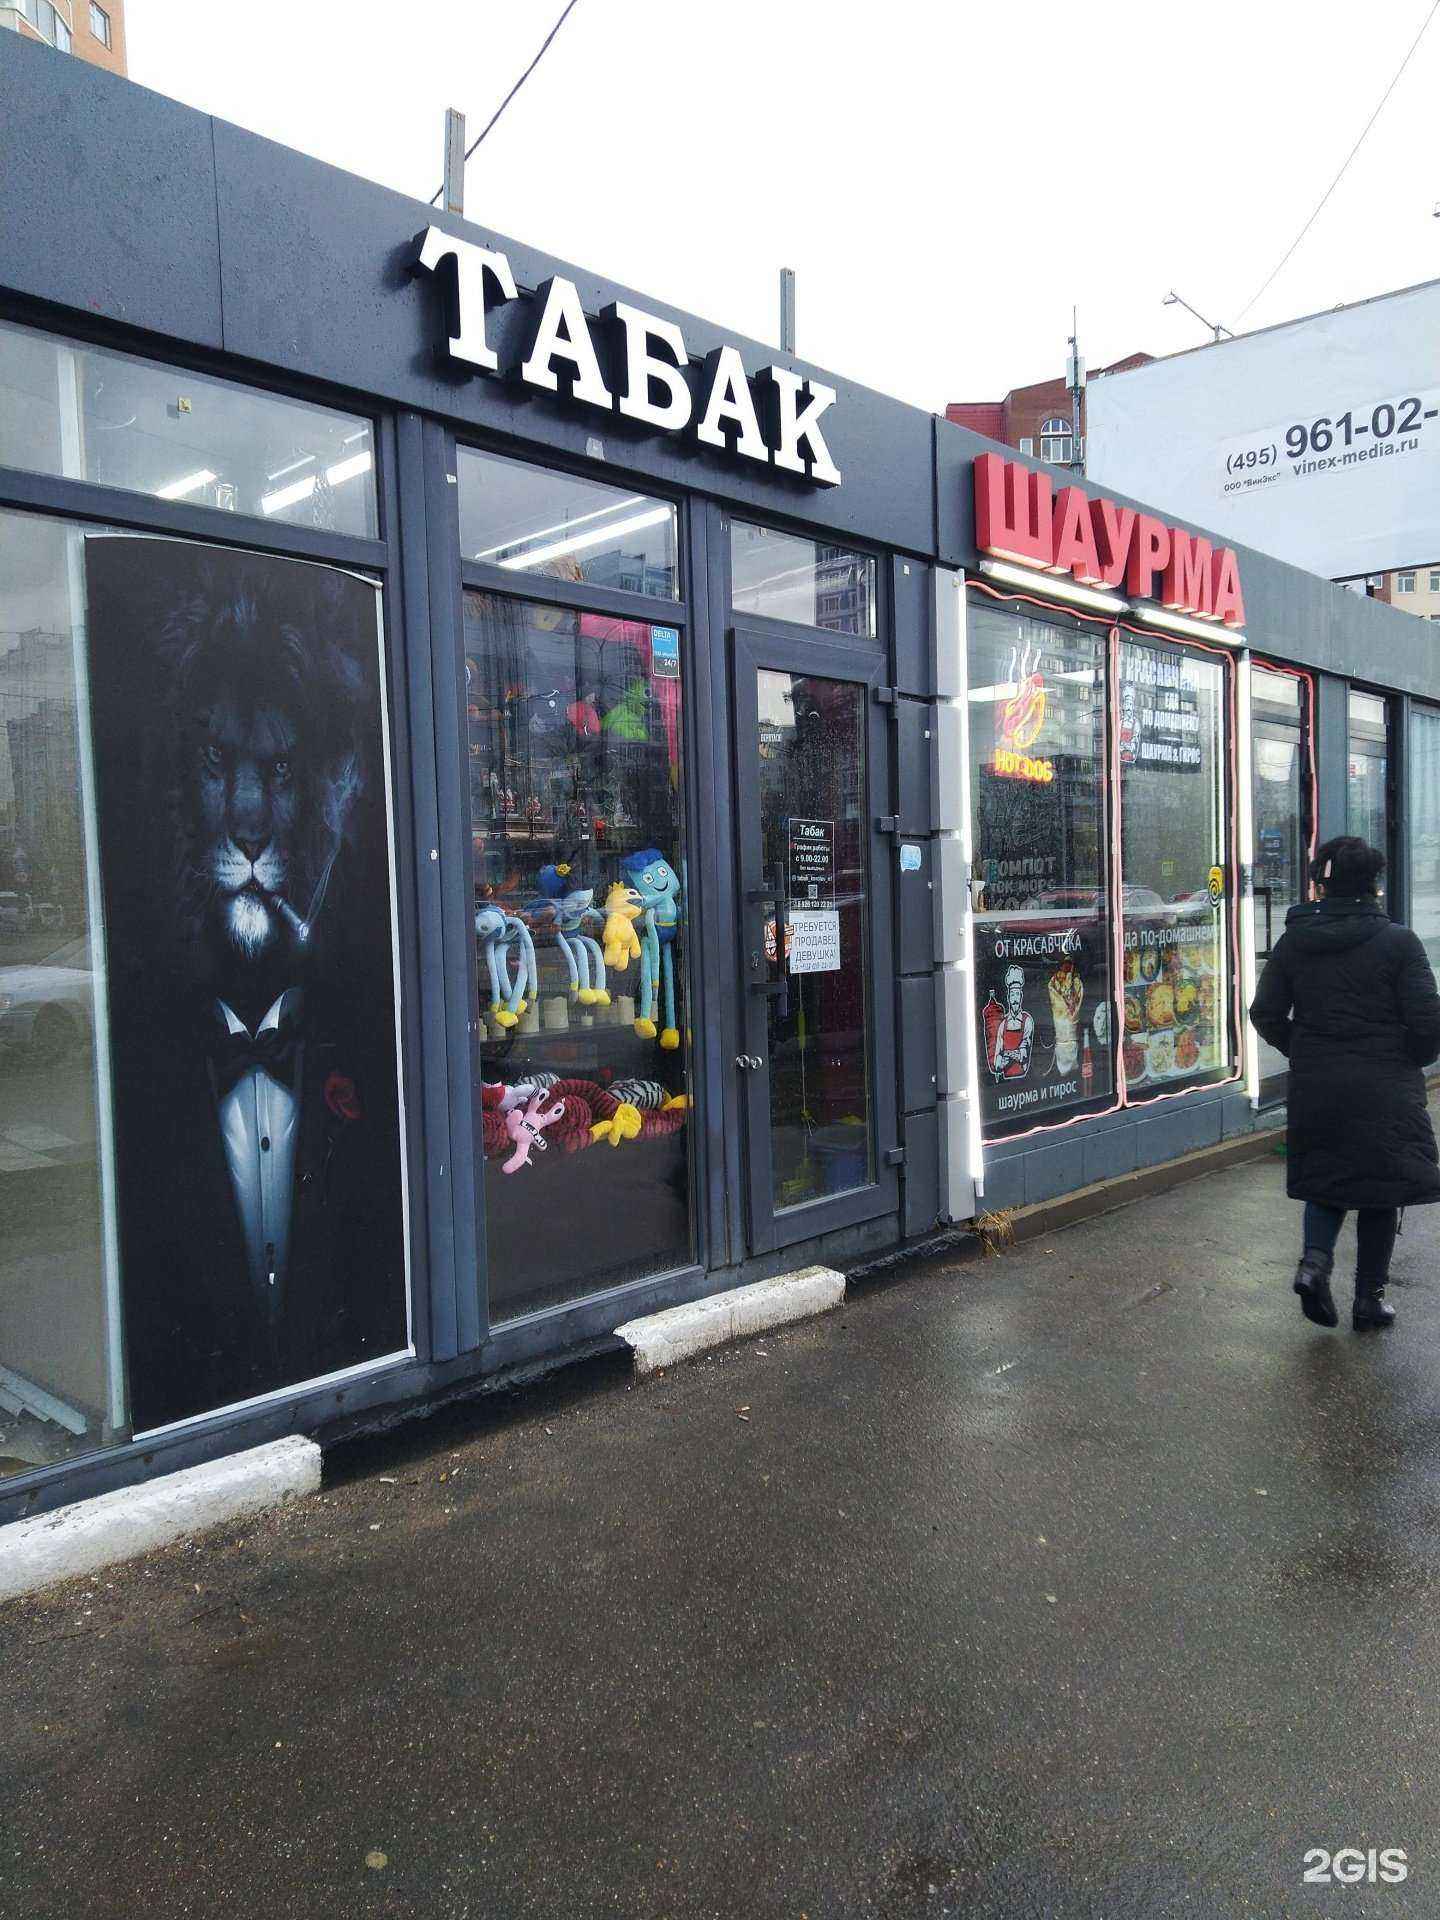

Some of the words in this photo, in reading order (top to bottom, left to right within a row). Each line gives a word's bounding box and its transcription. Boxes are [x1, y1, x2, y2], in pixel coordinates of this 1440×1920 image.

[417, 224, 842, 487] ТАБАК
[1226, 444, 1278, 475] (495)
[1285, 397, 1440, 459] 961-02-
[1292, 437, 1420, 477] vinex-media.ru
[1223, 481, 1242, 493] ООО
[974, 452, 1247, 629] ШАУРМА
[653, 628, 671, 639] DELTA
[663, 658, 677, 669] 24/7
[995, 749, 1021, 773] HOT
[1141, 742, 1172, 762] ШАУРМА
[1173, 747, 1179, 762] &
[1180, 746, 1201, 764] ГИРОС
[799, 824, 825, 838] Табак
[794, 920, 837, 932] ТРЕБУЕТСЯ
[794, 934, 837, 947] ПРОДАВЕЦ
[995, 939, 1011, 958] ОТ
[1121, 931, 1138, 951] да
[998, 1088, 1039, 1111] шаурма
[1041, 1087, 1047, 1099] и
[1049, 1080, 1078, 1100] гирос
